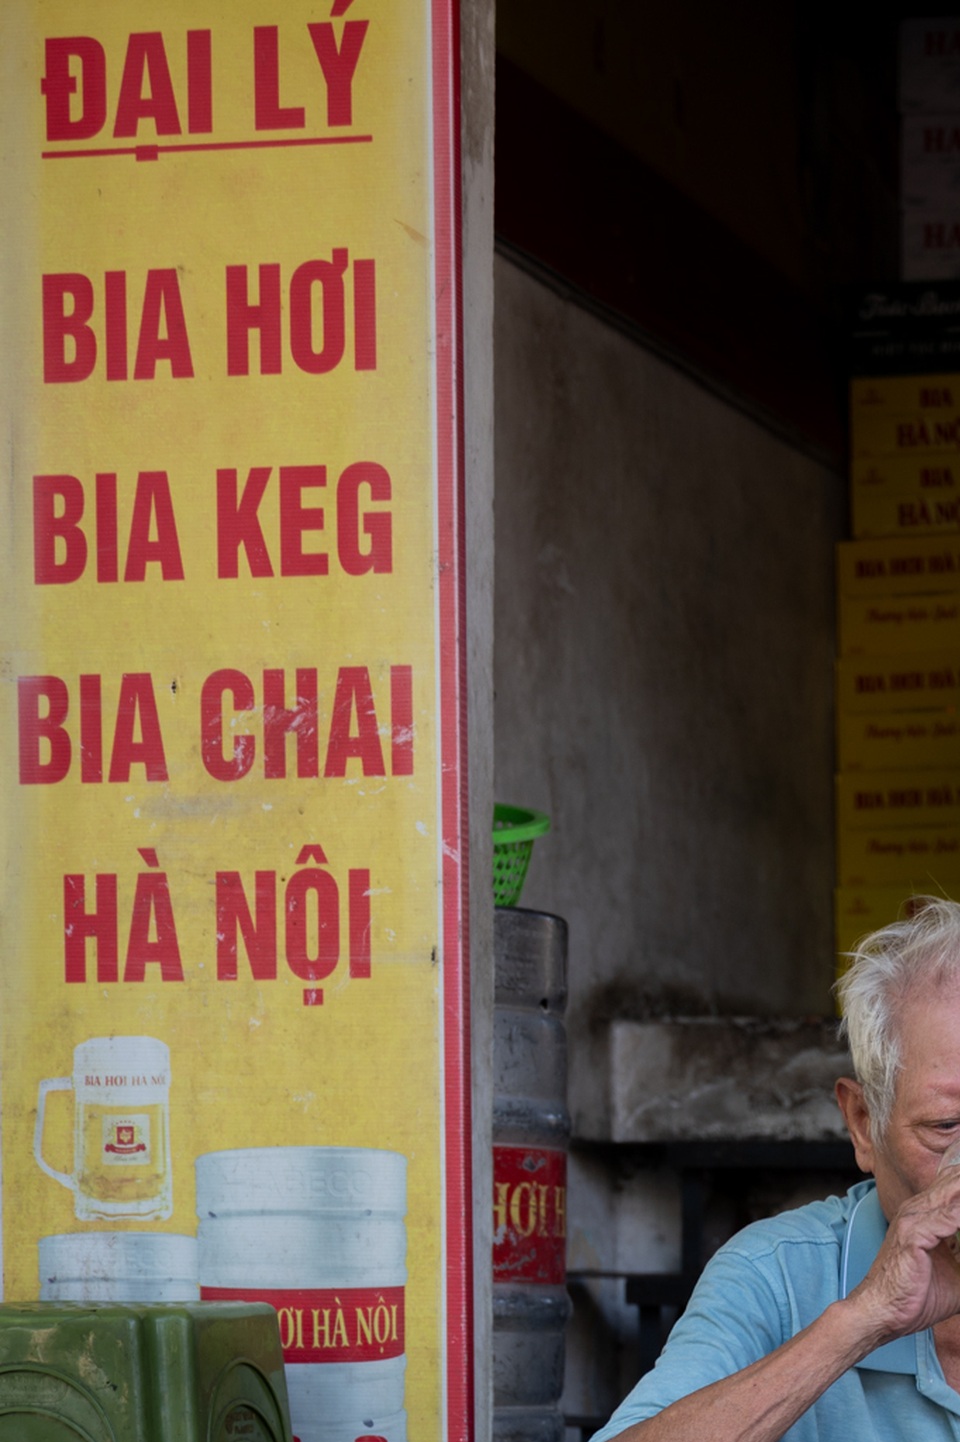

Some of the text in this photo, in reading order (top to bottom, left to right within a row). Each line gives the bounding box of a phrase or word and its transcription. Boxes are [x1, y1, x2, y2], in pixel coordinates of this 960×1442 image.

[41, 0, 370, 162] ĐẠI LÝ
[42, 247, 377, 384] BIA HƠI
[33, 461, 393, 585] BIA KEG
[17, 664, 414, 785] BIA CHAI
[63, 844, 372, 1006] HÀ NỘI
[277, 1295, 398, 1353] ƠI HÀ NỘI
